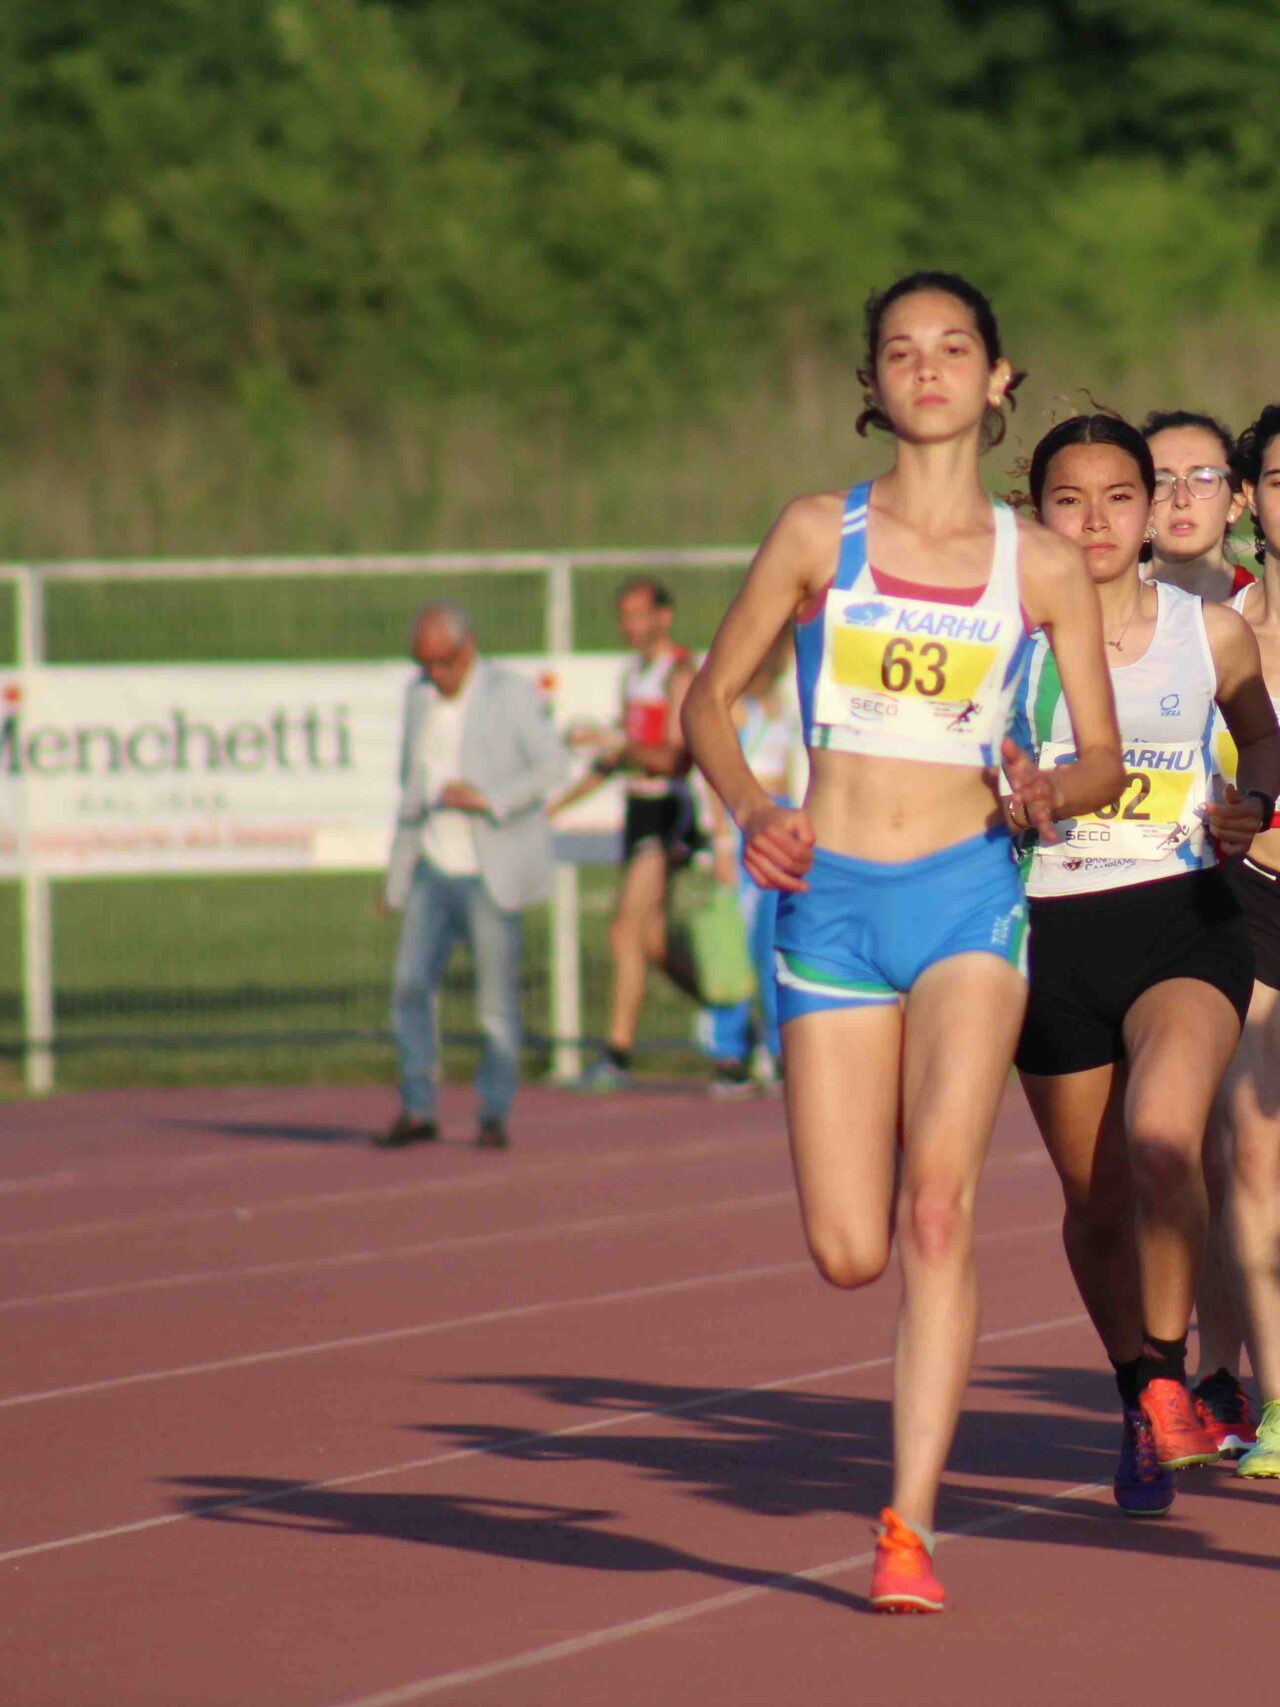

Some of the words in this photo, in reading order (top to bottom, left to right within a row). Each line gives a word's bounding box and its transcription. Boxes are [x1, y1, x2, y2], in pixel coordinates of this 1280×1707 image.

[895, 609, 1002, 642] KARHU
[881, 637, 948, 696] 63
[850, 697, 899, 716] SECO
[1122, 750, 1195, 770] ARHU
[1066, 830, 1111, 842] SECO
